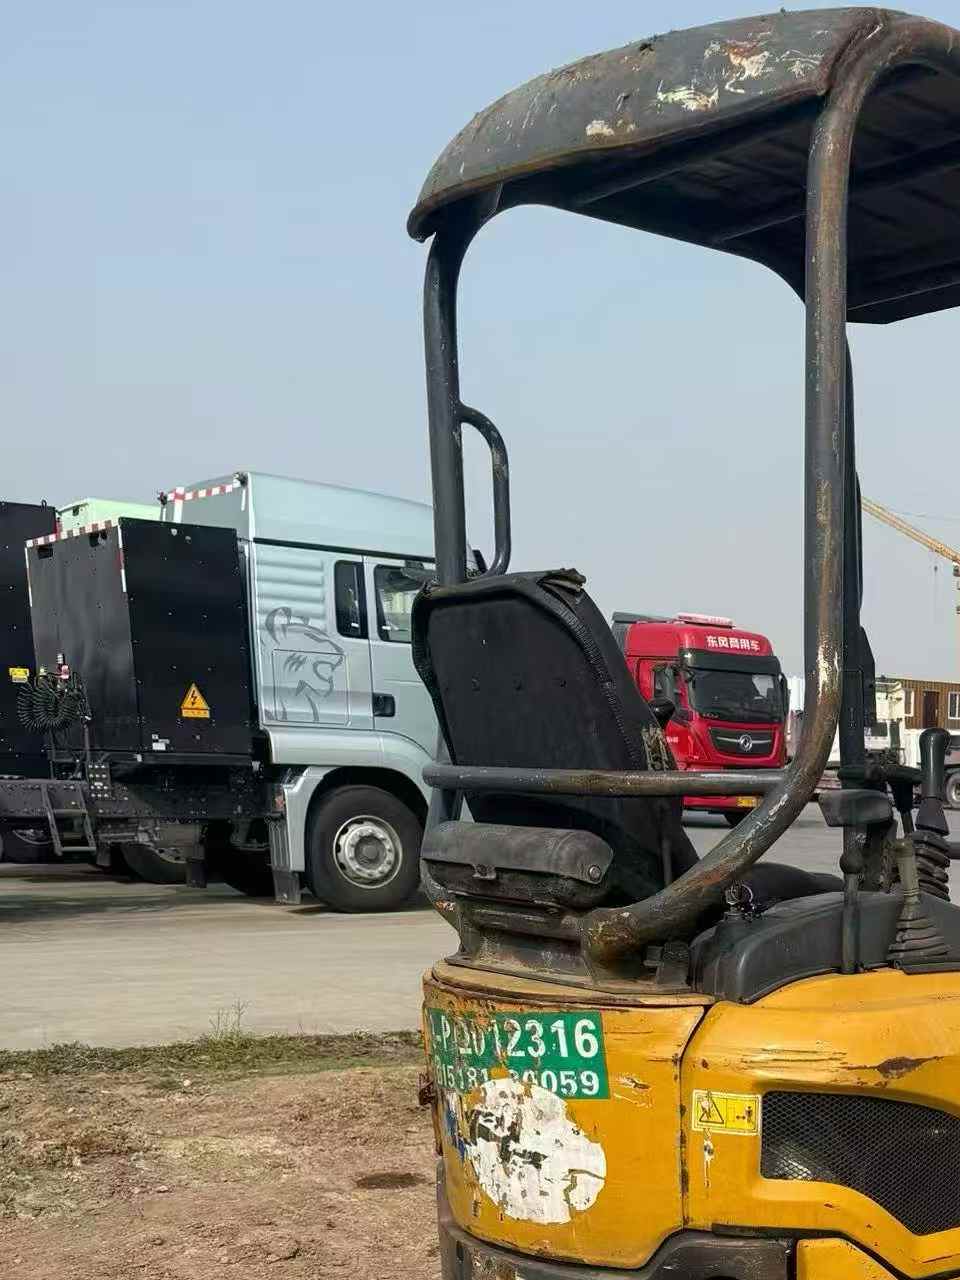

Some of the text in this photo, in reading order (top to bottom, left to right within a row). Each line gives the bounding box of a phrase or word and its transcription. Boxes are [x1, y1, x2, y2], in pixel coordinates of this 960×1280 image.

[706, 635, 760, 652] 东风商用车
